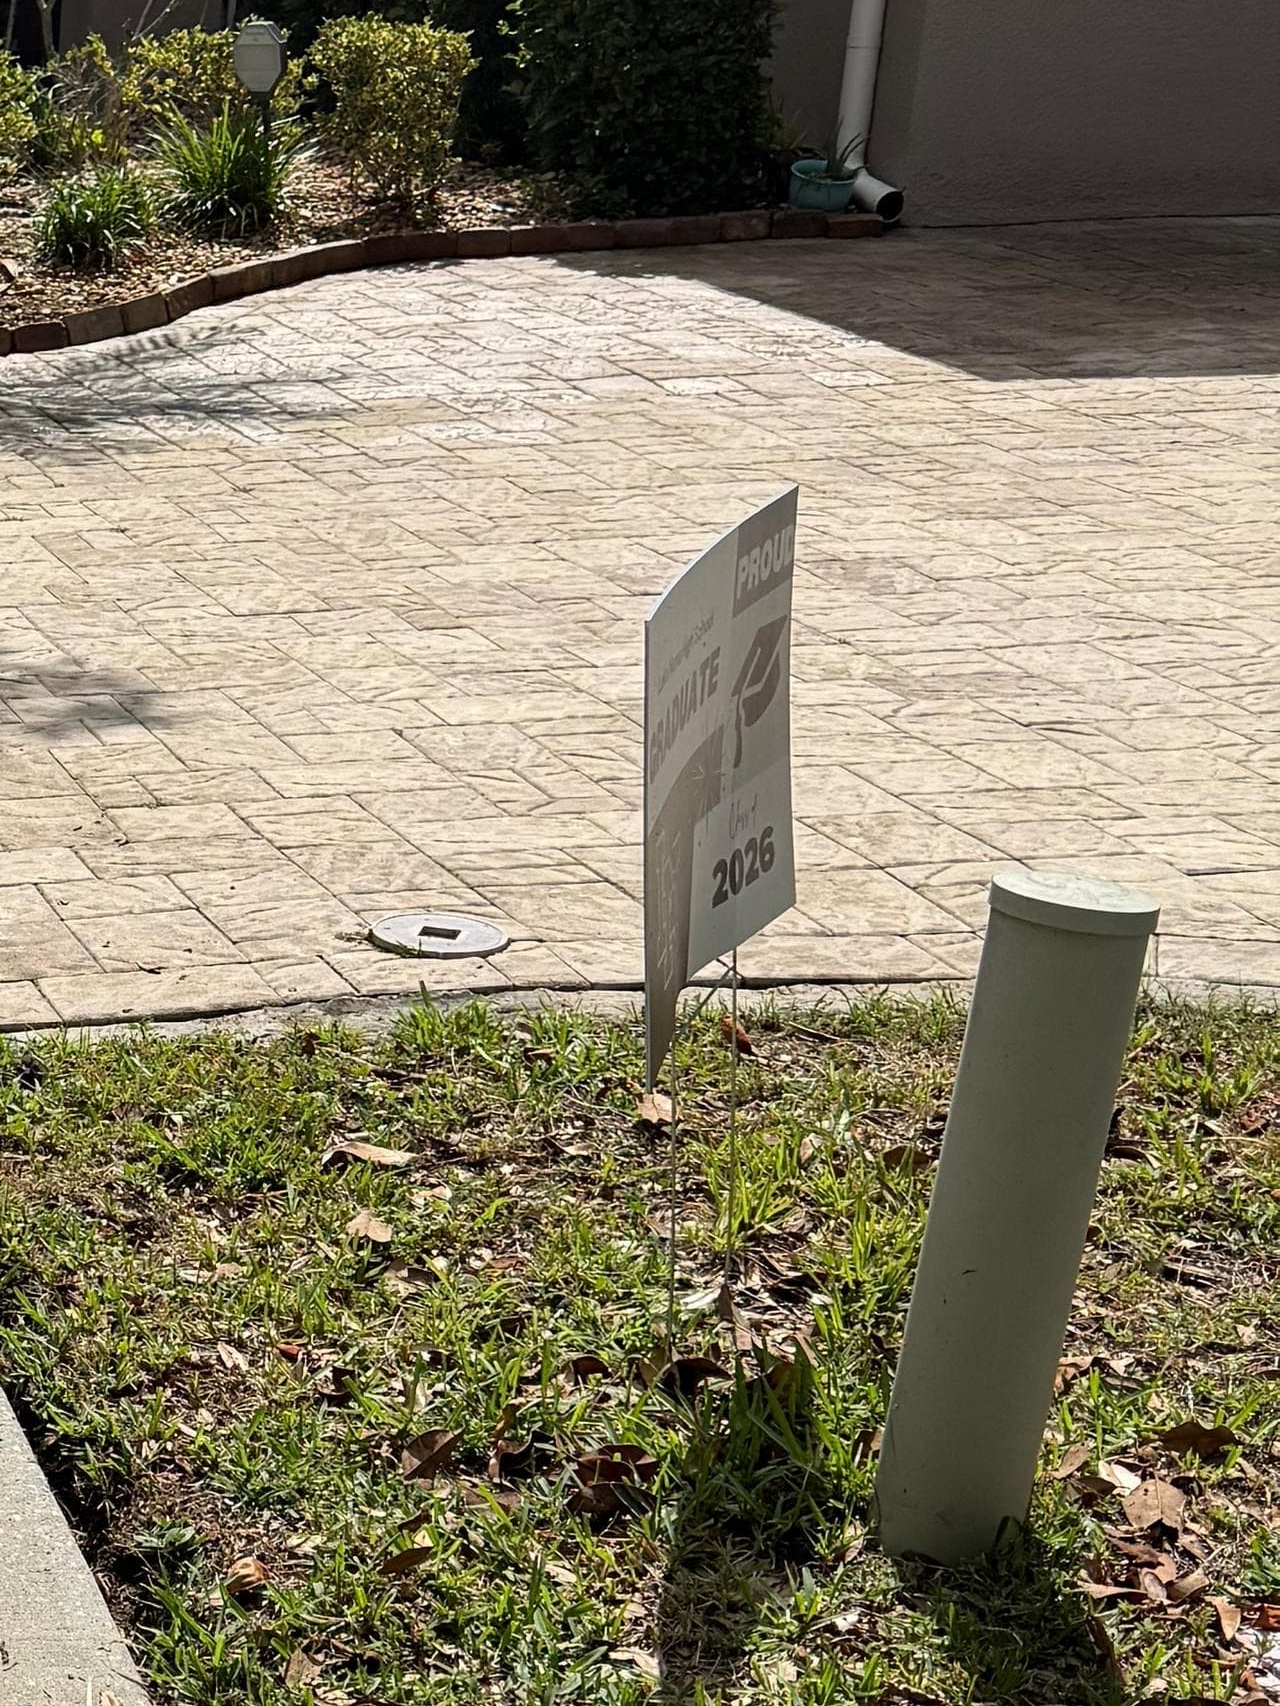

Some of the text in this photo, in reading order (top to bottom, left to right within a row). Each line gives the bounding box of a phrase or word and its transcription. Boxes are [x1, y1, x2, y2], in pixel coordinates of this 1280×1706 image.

[736, 524, 795, 599] PROUD
[648, 645, 721, 785] GRADUATE
[712, 825, 776, 909] 2026
